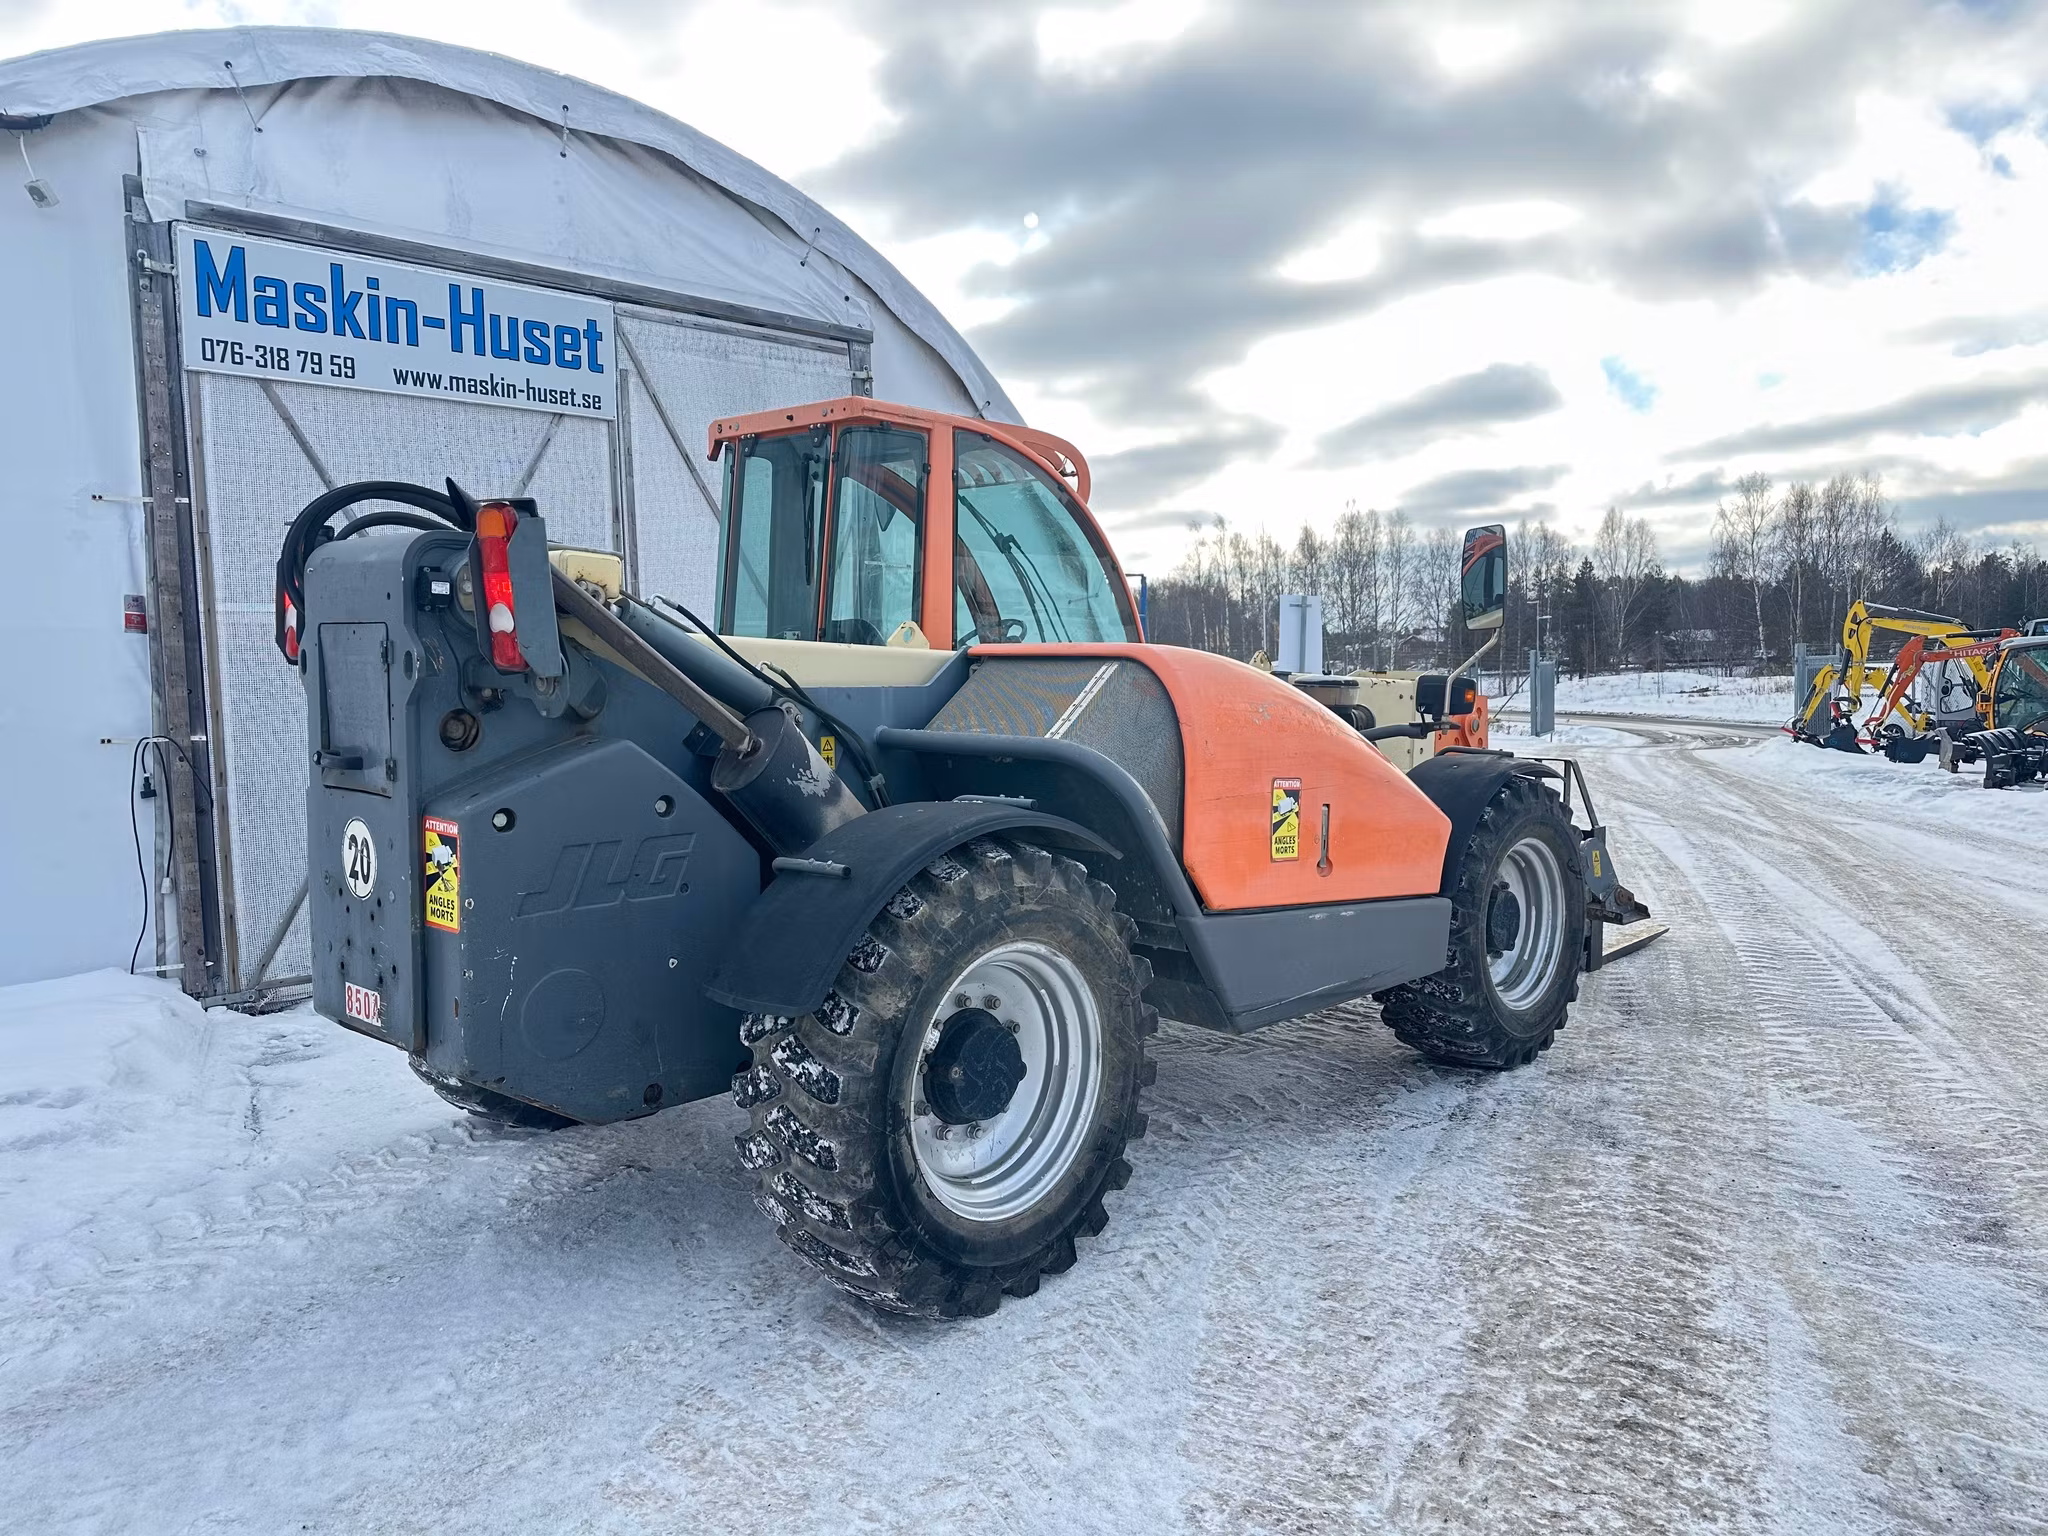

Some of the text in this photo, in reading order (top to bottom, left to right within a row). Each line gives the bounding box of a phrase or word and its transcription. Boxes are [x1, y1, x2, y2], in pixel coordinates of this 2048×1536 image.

[193, 238, 604, 374] Maskin-Huset
[201, 337, 356, 380] 076-318 79 59
[393, 367, 602, 411] www.maskin-huset.se
[1954, 645, 1994, 657] HITAC
[1273, 780, 1300, 788] ATTENTION
[425, 819, 458, 835] ATTENTION
[1274, 836, 1296, 845] ANGLES
[1275, 846, 1295, 854] MORTS
[348, 833, 372, 885] 20
[516, 832, 697, 919] JLG
[429, 893, 455, 911] ANGLES
[430, 906, 454, 922] MORTS
